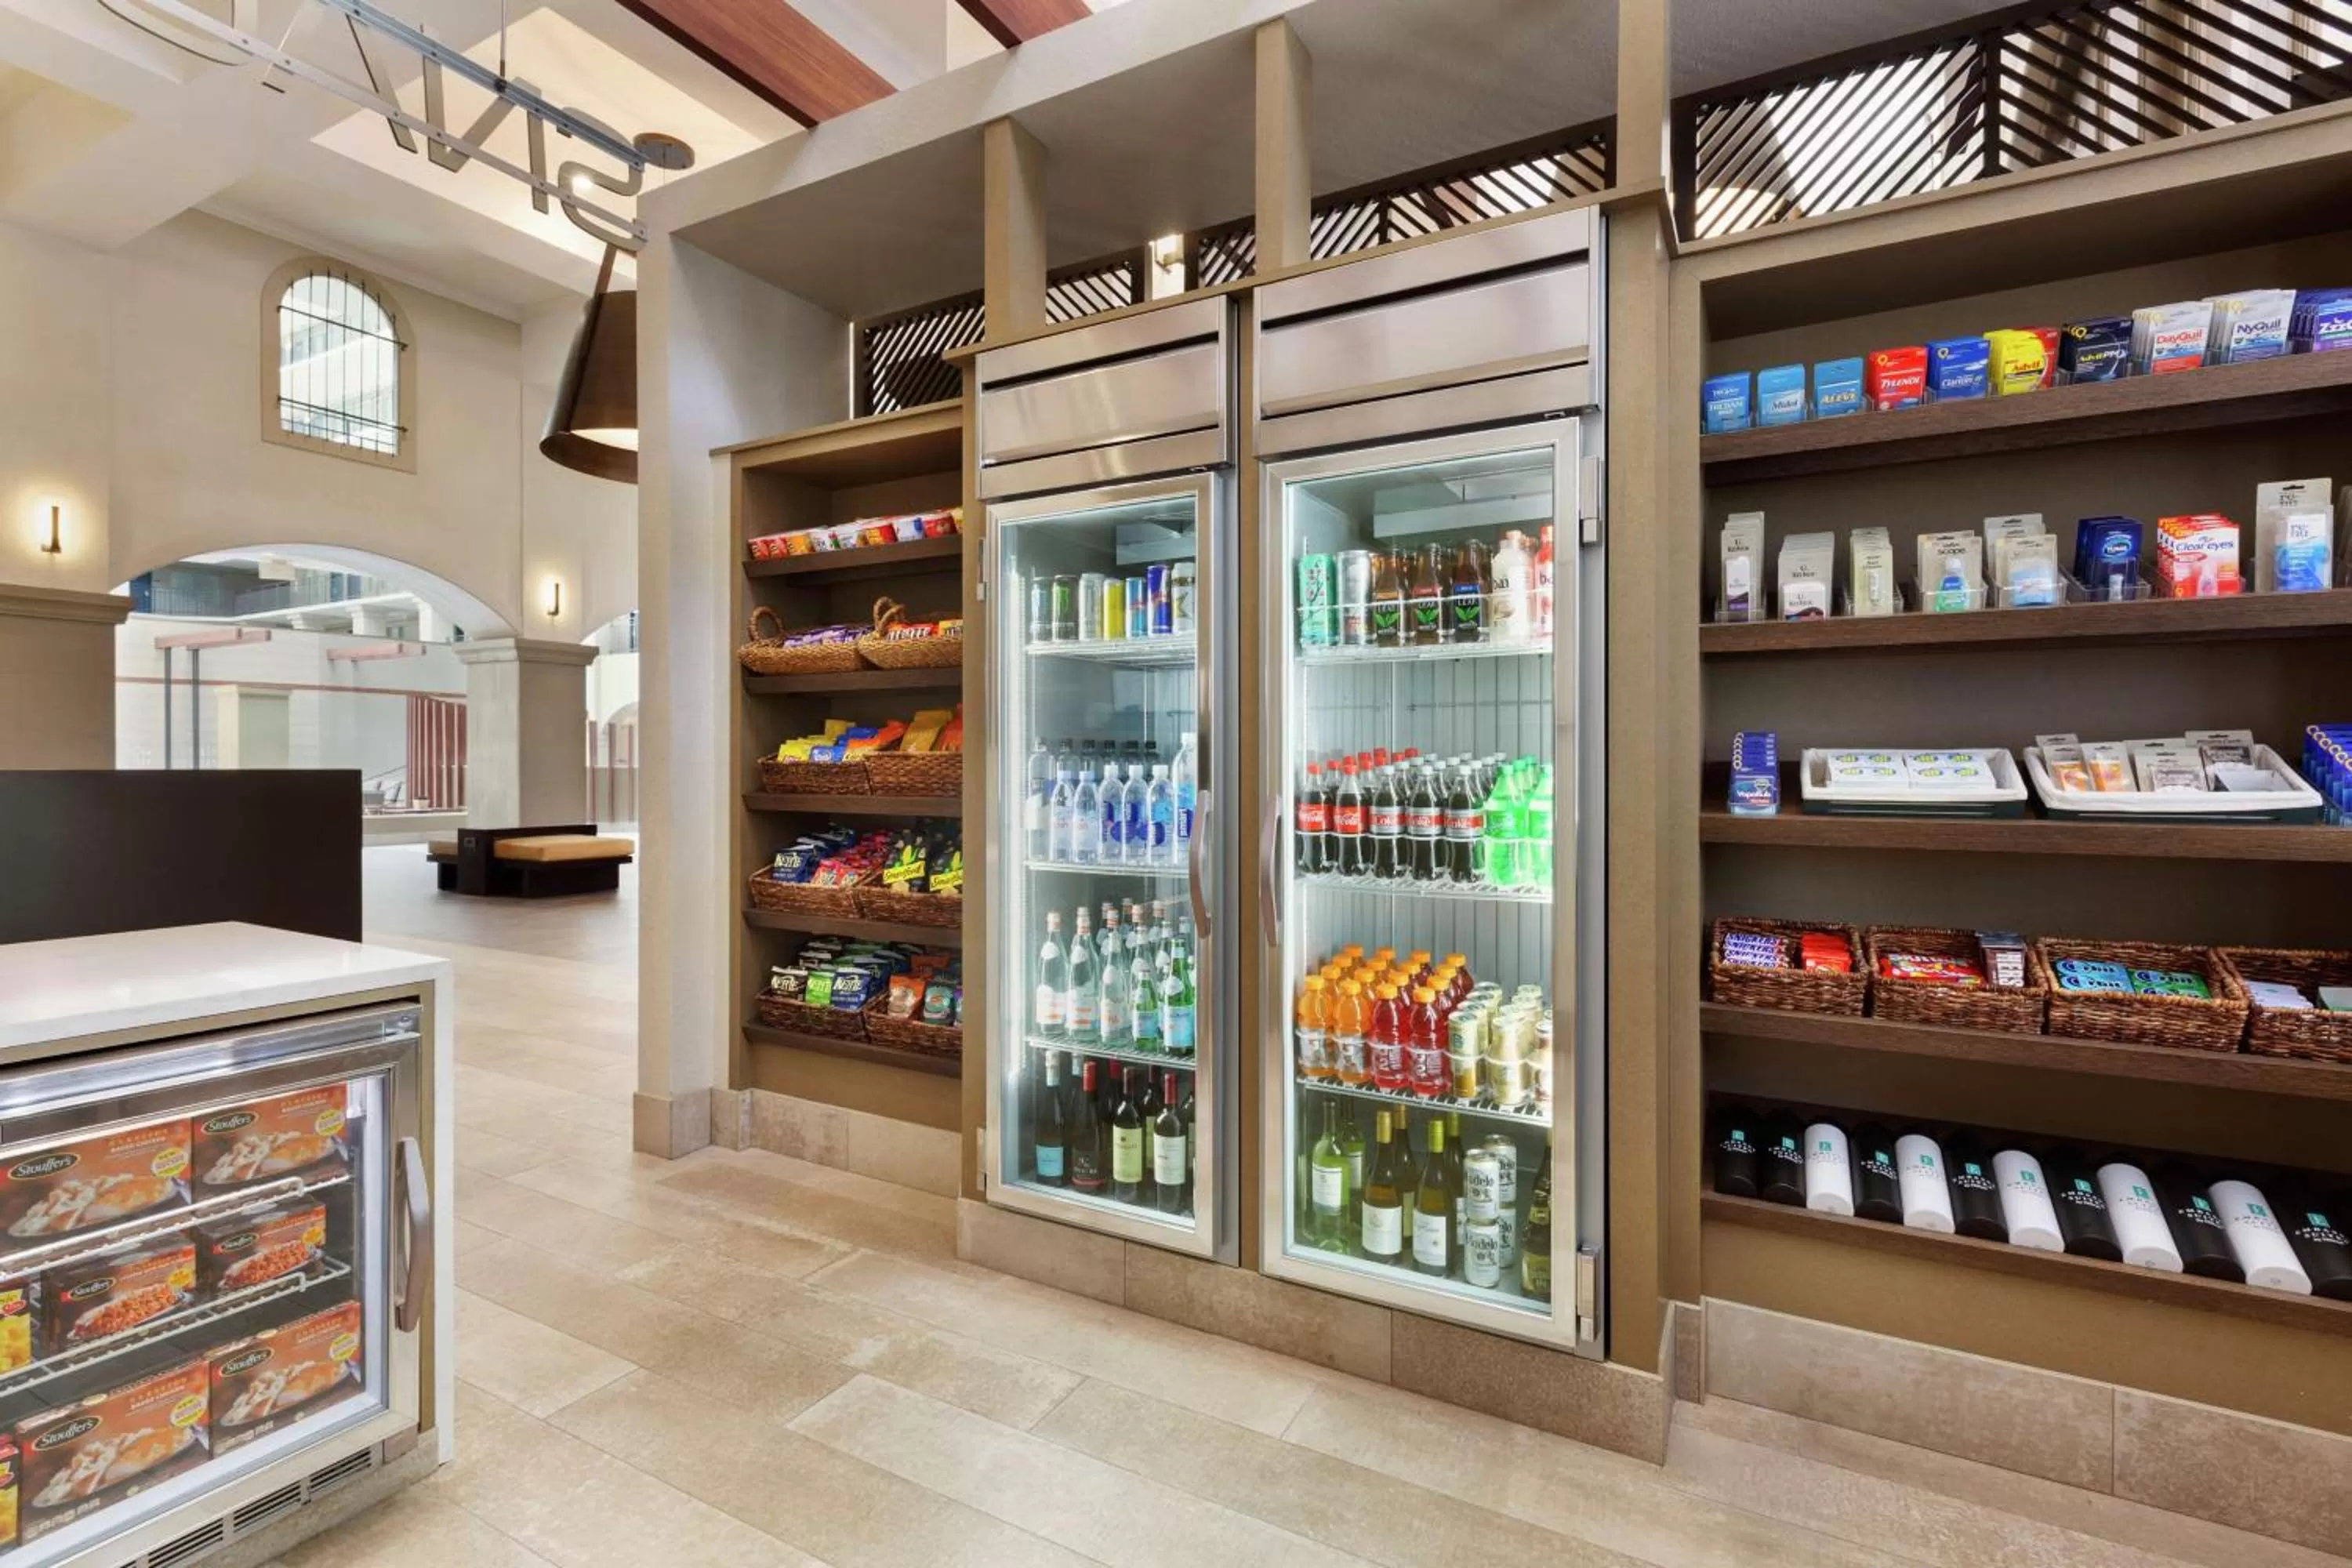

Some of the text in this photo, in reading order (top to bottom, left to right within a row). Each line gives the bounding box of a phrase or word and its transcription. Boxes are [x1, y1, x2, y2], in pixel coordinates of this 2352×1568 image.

[2237, 319, 2281, 335] NyQuil
[2157, 328, 2202, 343] DayQuil
[2013, 361, 2041, 372] Advil
[1881, 376, 1921, 389] TYLENOL
[2176, 540, 2234, 552] Clear eyes
